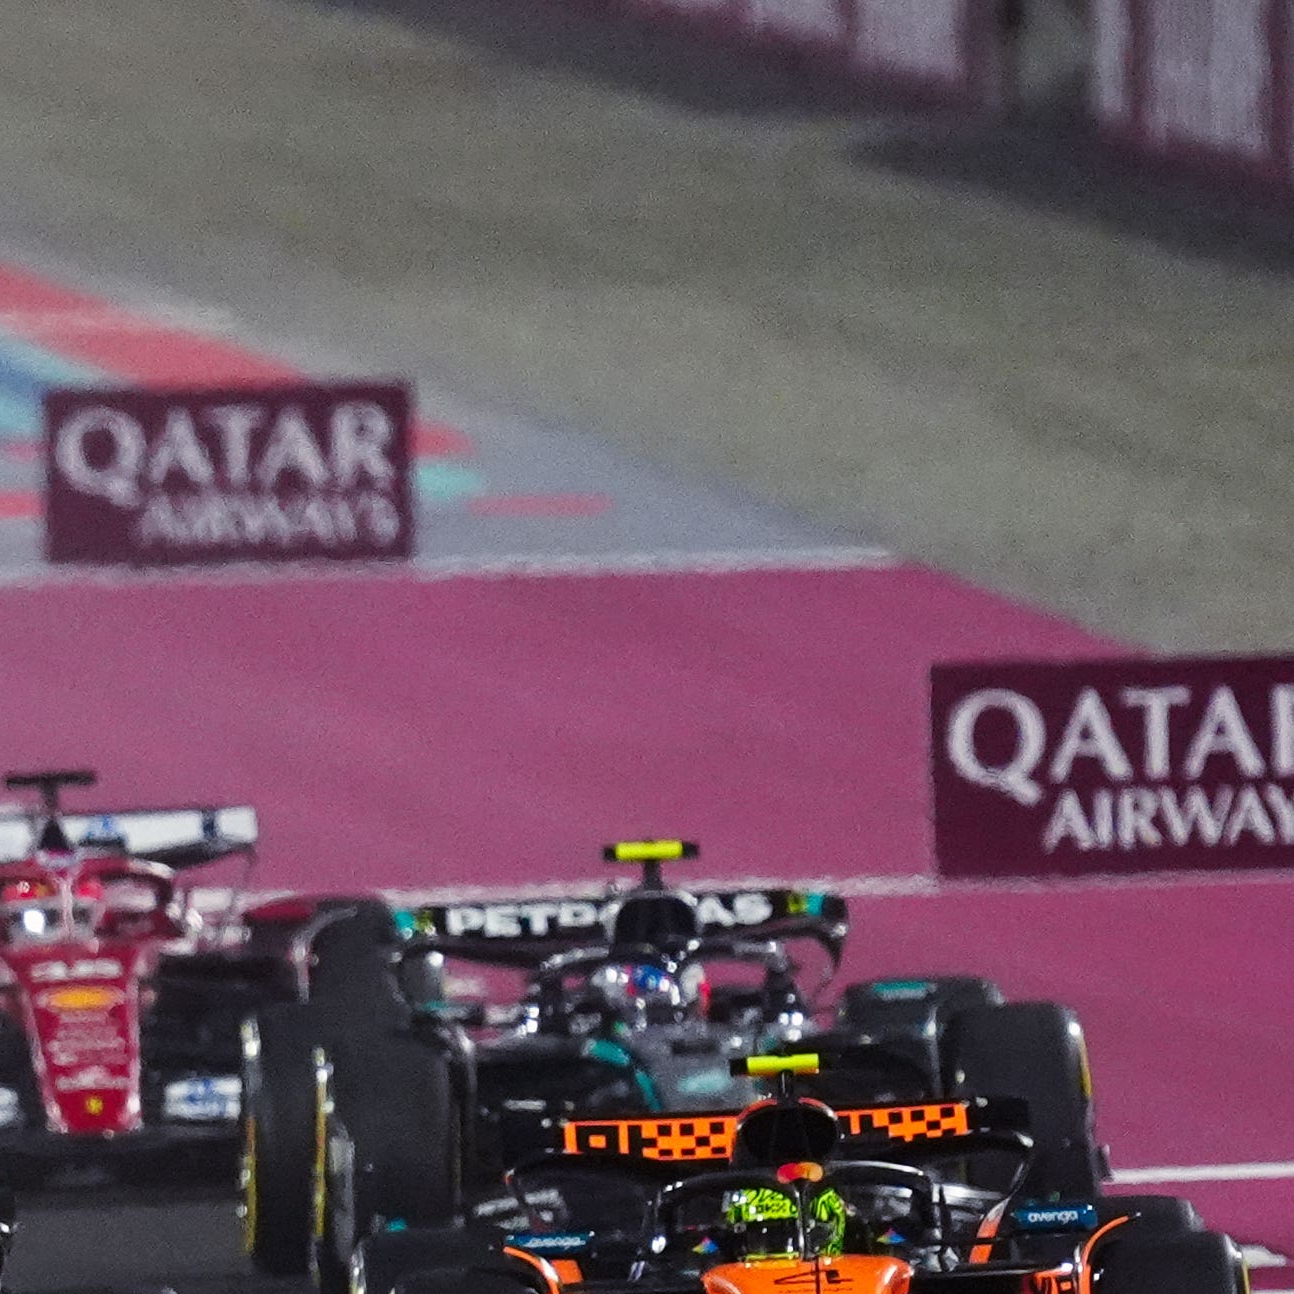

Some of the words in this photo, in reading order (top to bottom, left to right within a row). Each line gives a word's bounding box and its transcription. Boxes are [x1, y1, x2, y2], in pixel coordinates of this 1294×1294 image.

[55, 403, 395, 507] QATAR
[446, 892, 774, 937] PETRAS
[1026, 1210, 1079, 1224] avenga
